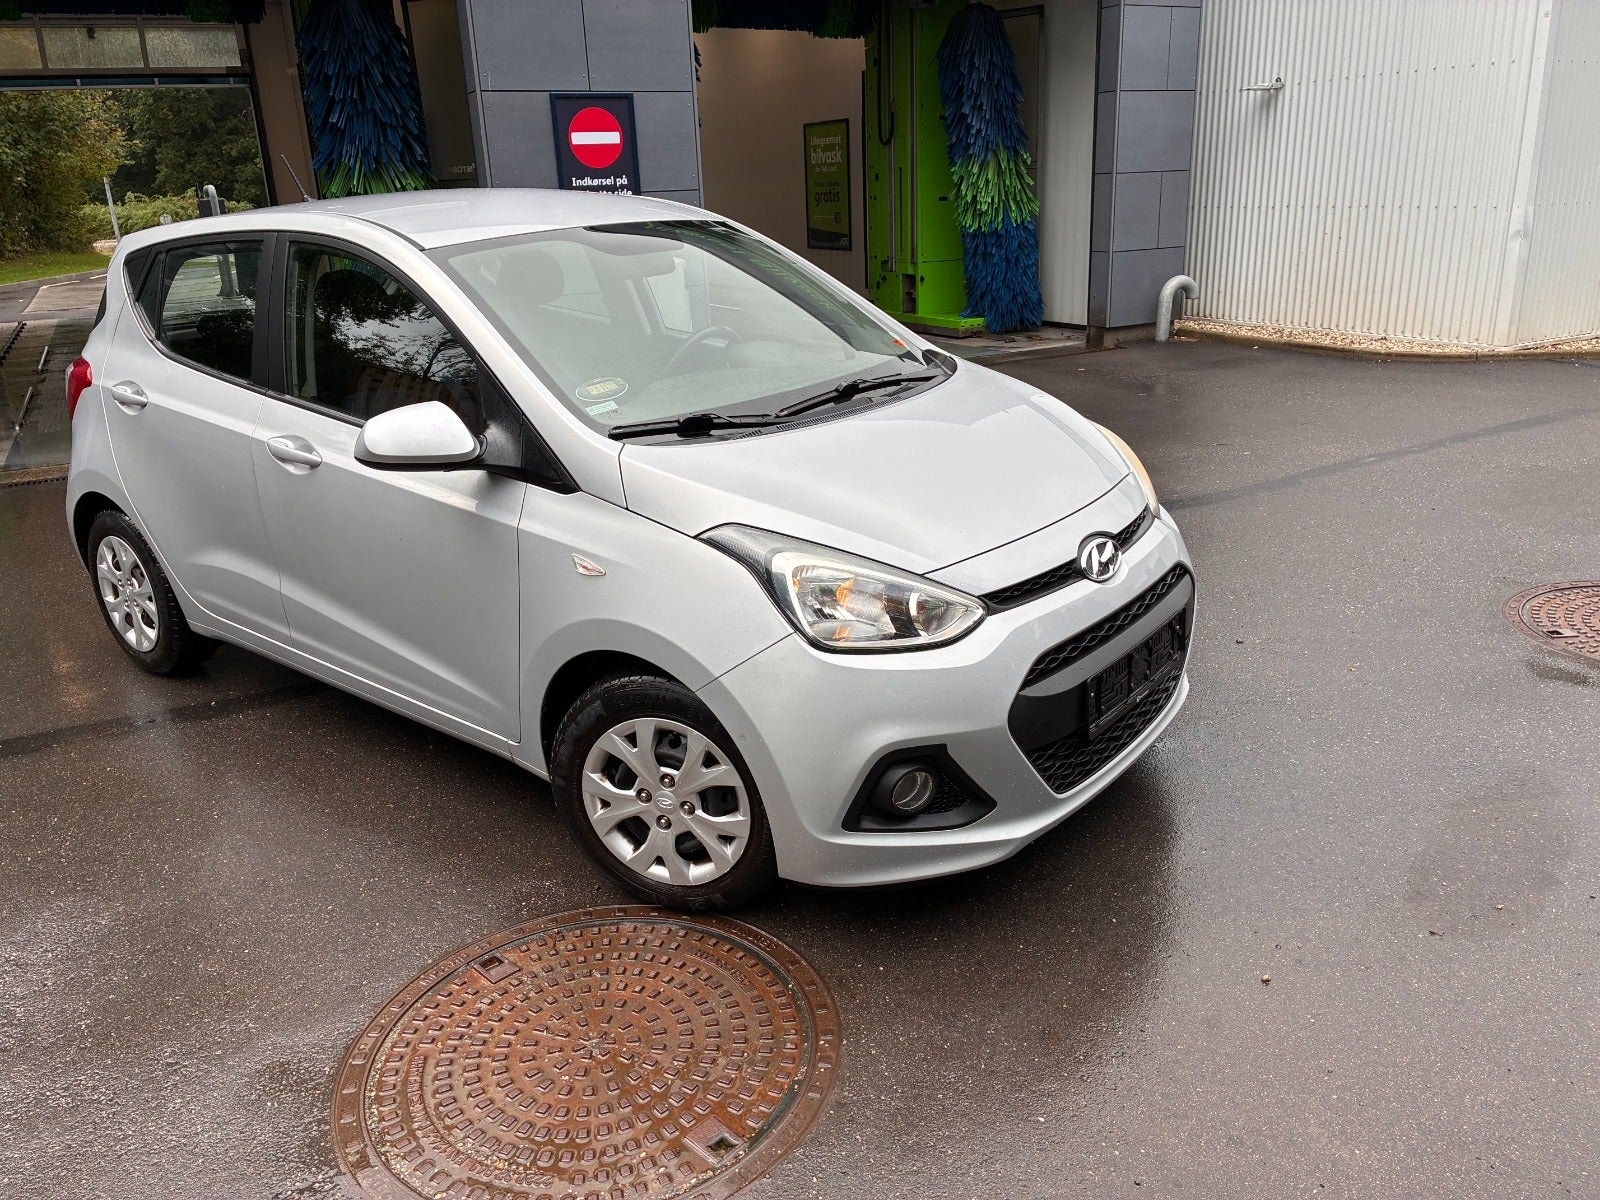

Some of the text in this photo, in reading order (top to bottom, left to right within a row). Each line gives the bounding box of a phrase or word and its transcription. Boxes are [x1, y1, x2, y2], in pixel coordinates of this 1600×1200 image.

[811, 146, 841, 163] bilvask
[571, 174, 628, 187] Indkørsel på
[814, 189, 841, 206] gratis
